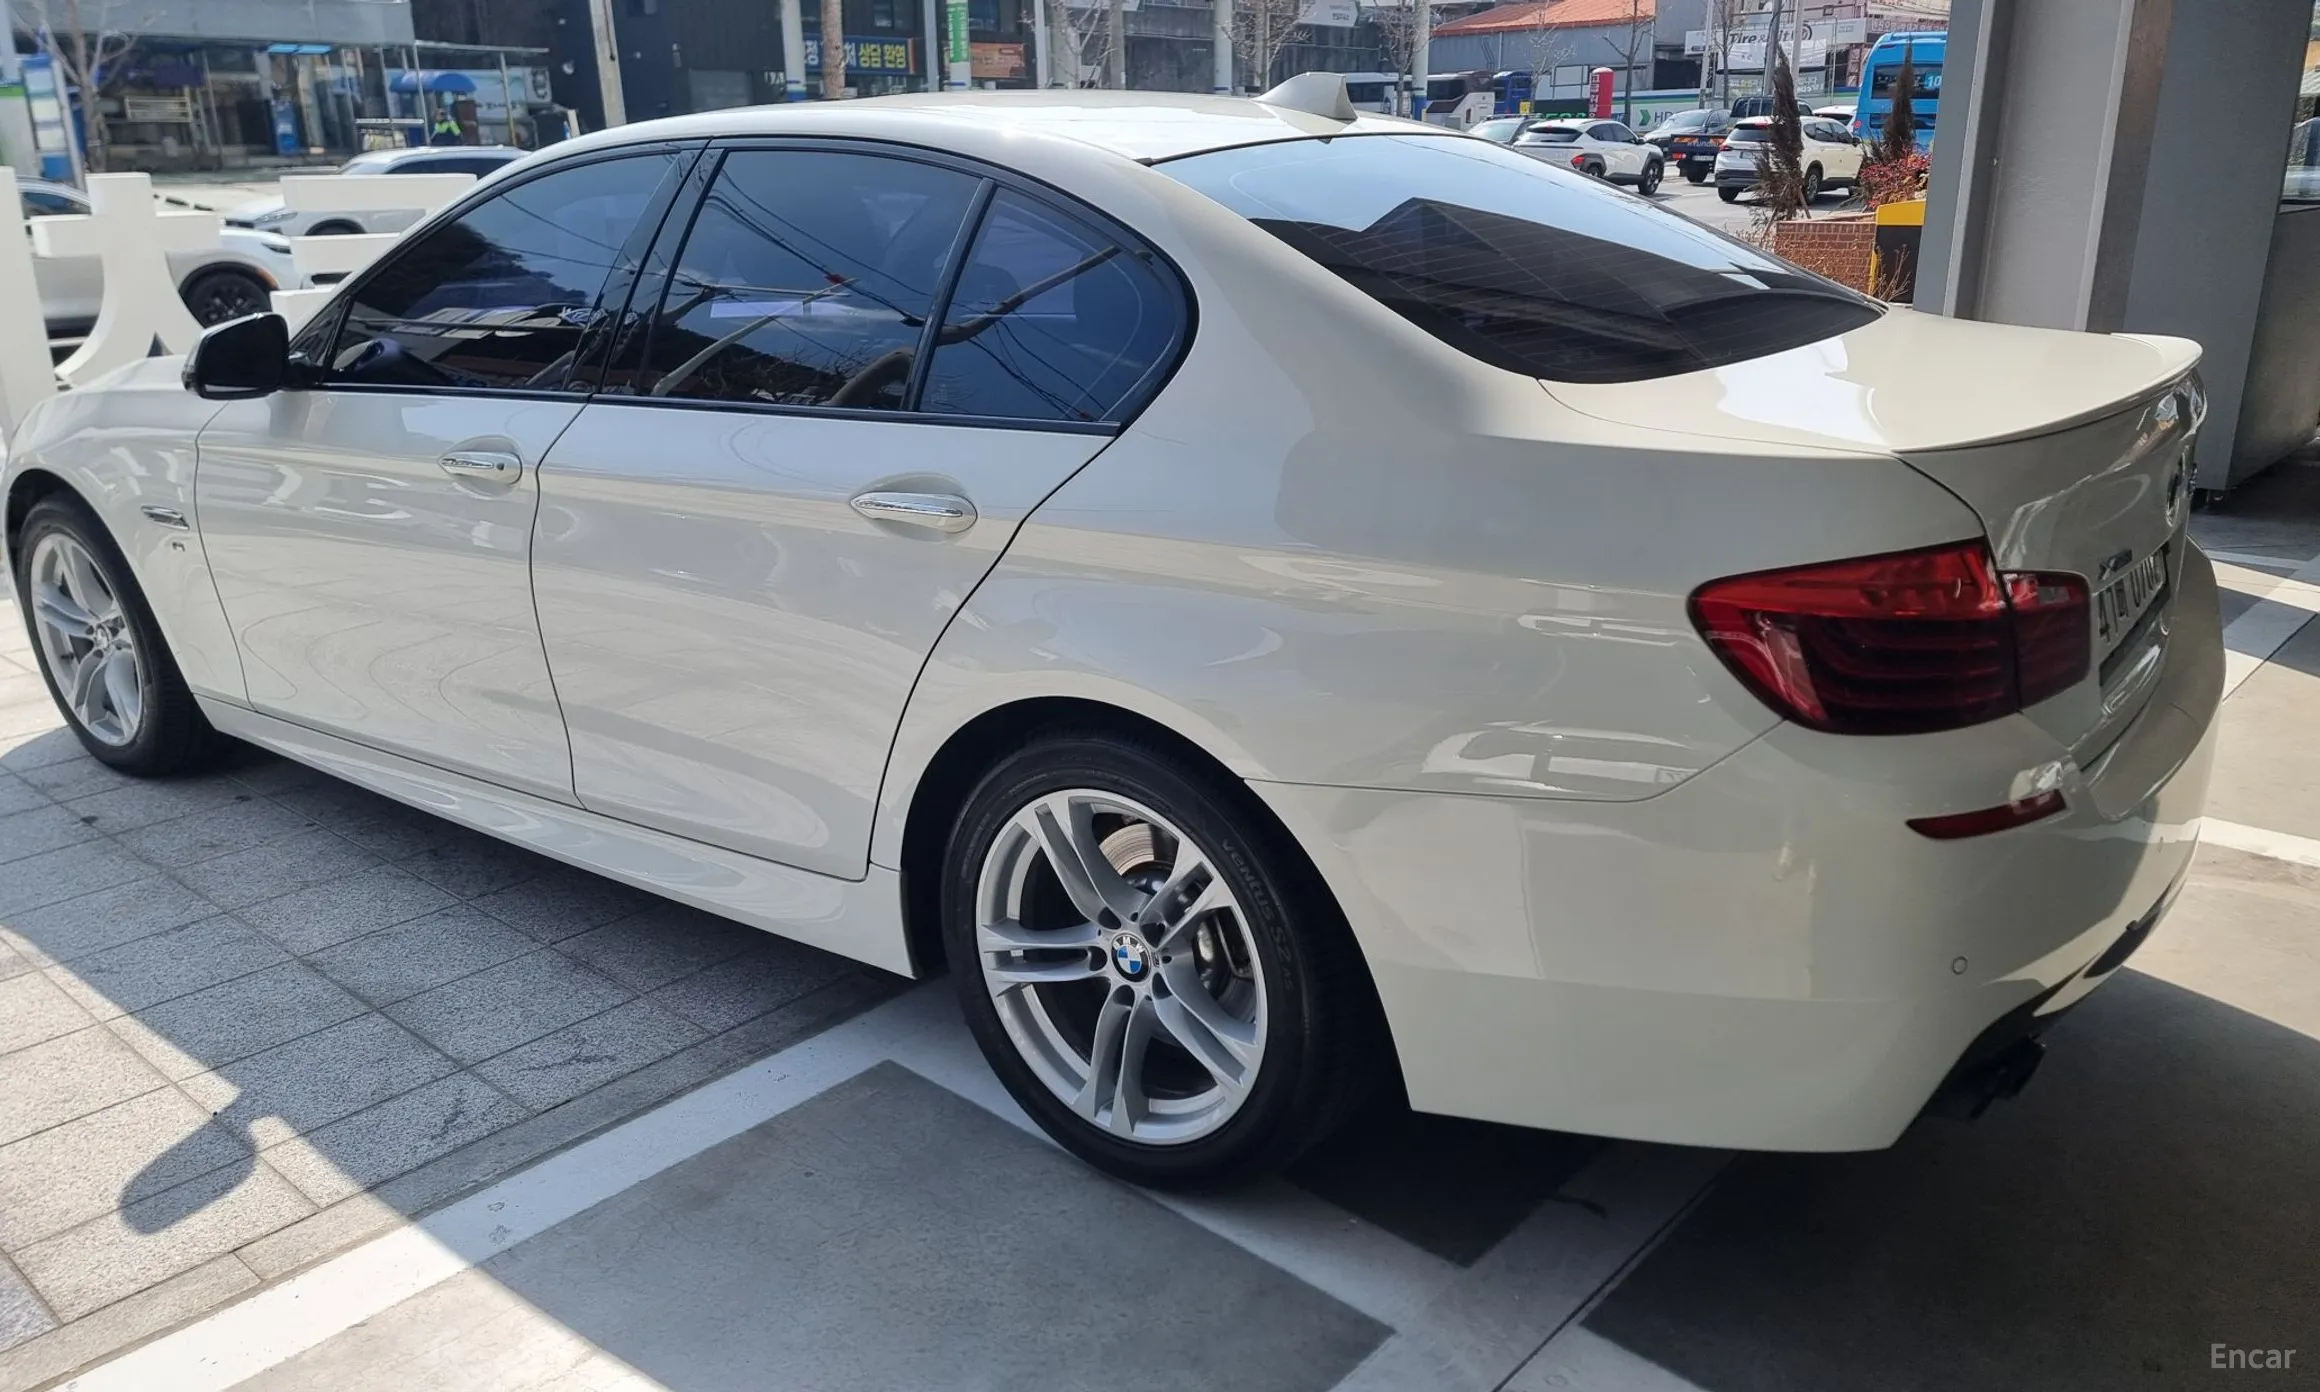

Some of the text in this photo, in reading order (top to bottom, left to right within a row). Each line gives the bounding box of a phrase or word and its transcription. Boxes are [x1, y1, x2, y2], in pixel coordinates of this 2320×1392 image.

[859, 42, 880, 68] 상담
[883, 44, 906, 69] 환영
[1113, 936, 1146, 953] BMW
